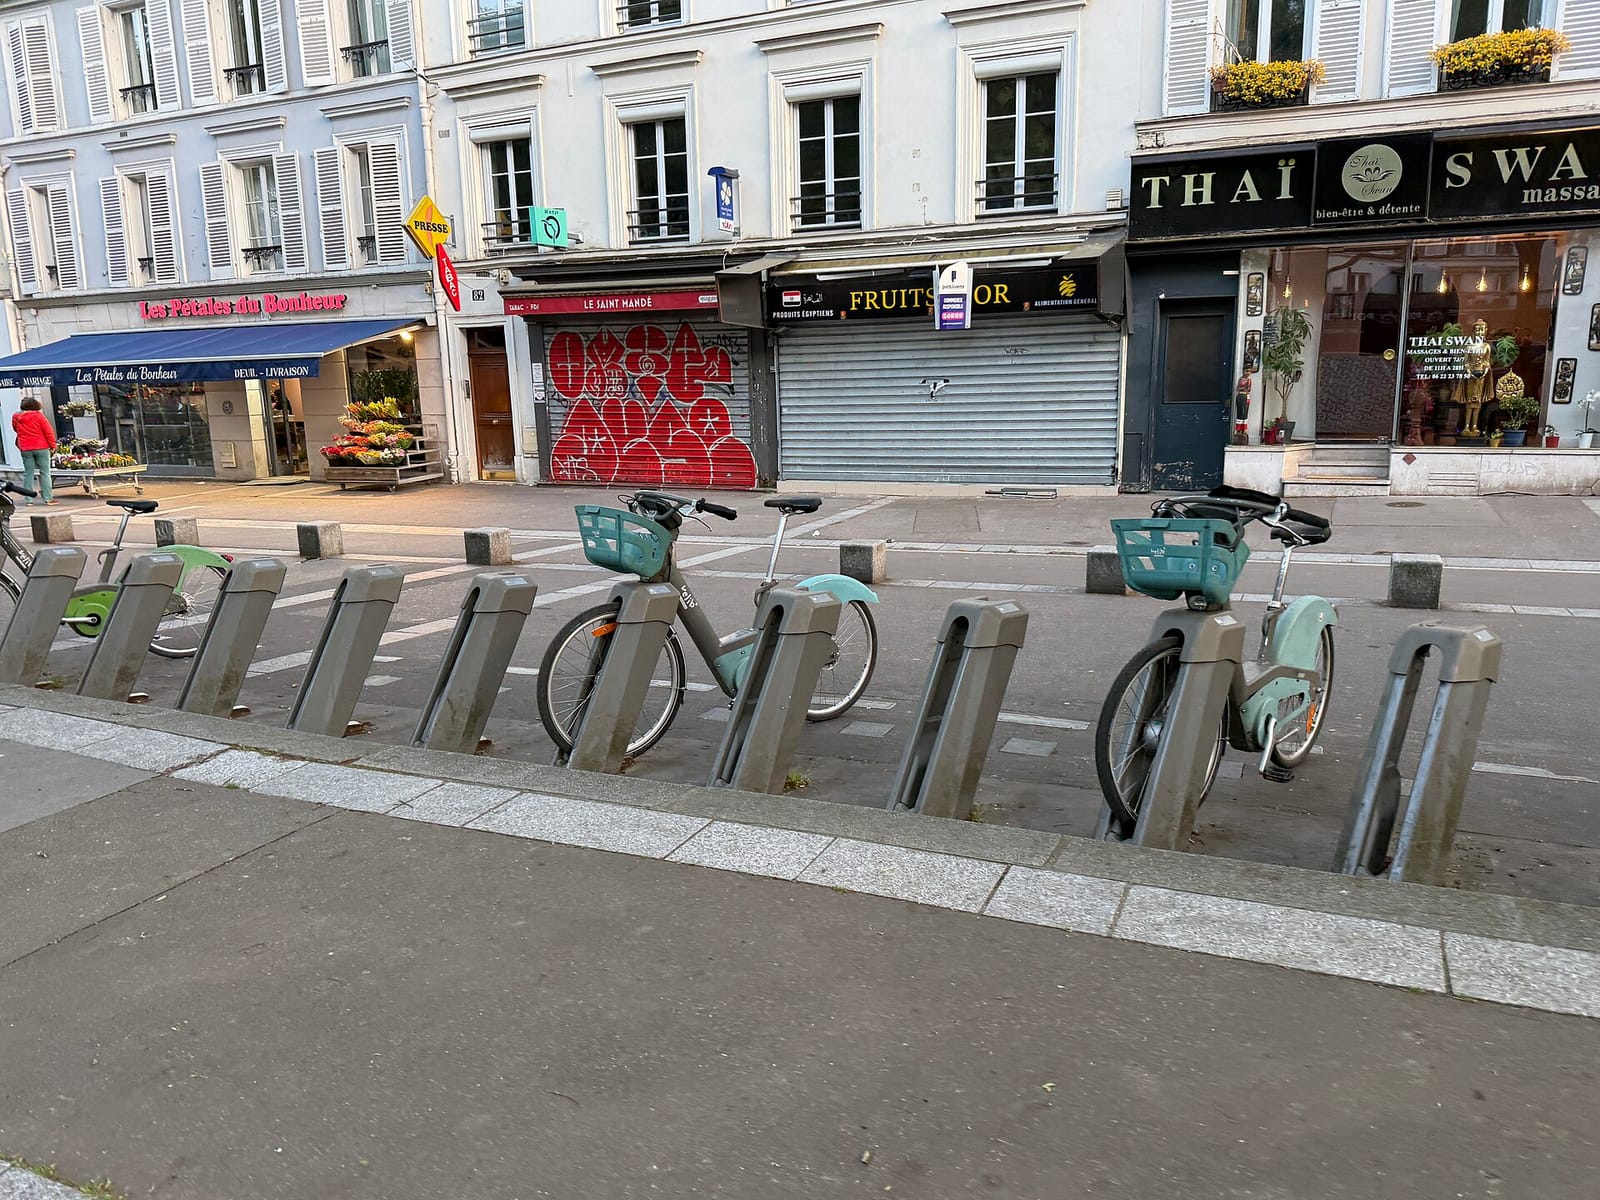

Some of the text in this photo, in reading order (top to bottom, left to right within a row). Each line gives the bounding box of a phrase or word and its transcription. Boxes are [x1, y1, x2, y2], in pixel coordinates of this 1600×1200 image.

[1445, 142, 1600, 189] SWA
[1142, 158, 1296, 208] THAÏ
[1367, 206, 1375, 215] &
[1379, 203, 1420, 214] détente
[414, 220, 449, 234] PRESSE
[442, 257, 457, 297] TABAC
[473, 290, 484, 301] 82
[584, 296, 653, 309] LE SAINT MANDÉ
[850, 287, 934, 311] FRUITS
[140, 292, 347, 319] Les Pétales du Bonheur
[1409, 335, 1485, 347] THAI SWAN
[75, 365, 177, 382] Les Pétales du Bonheur
[234, 368, 258, 378] DEUIL
[265, 366, 309, 377] LIVRAISON
[23, 376, 52, 386] MARIAGE
